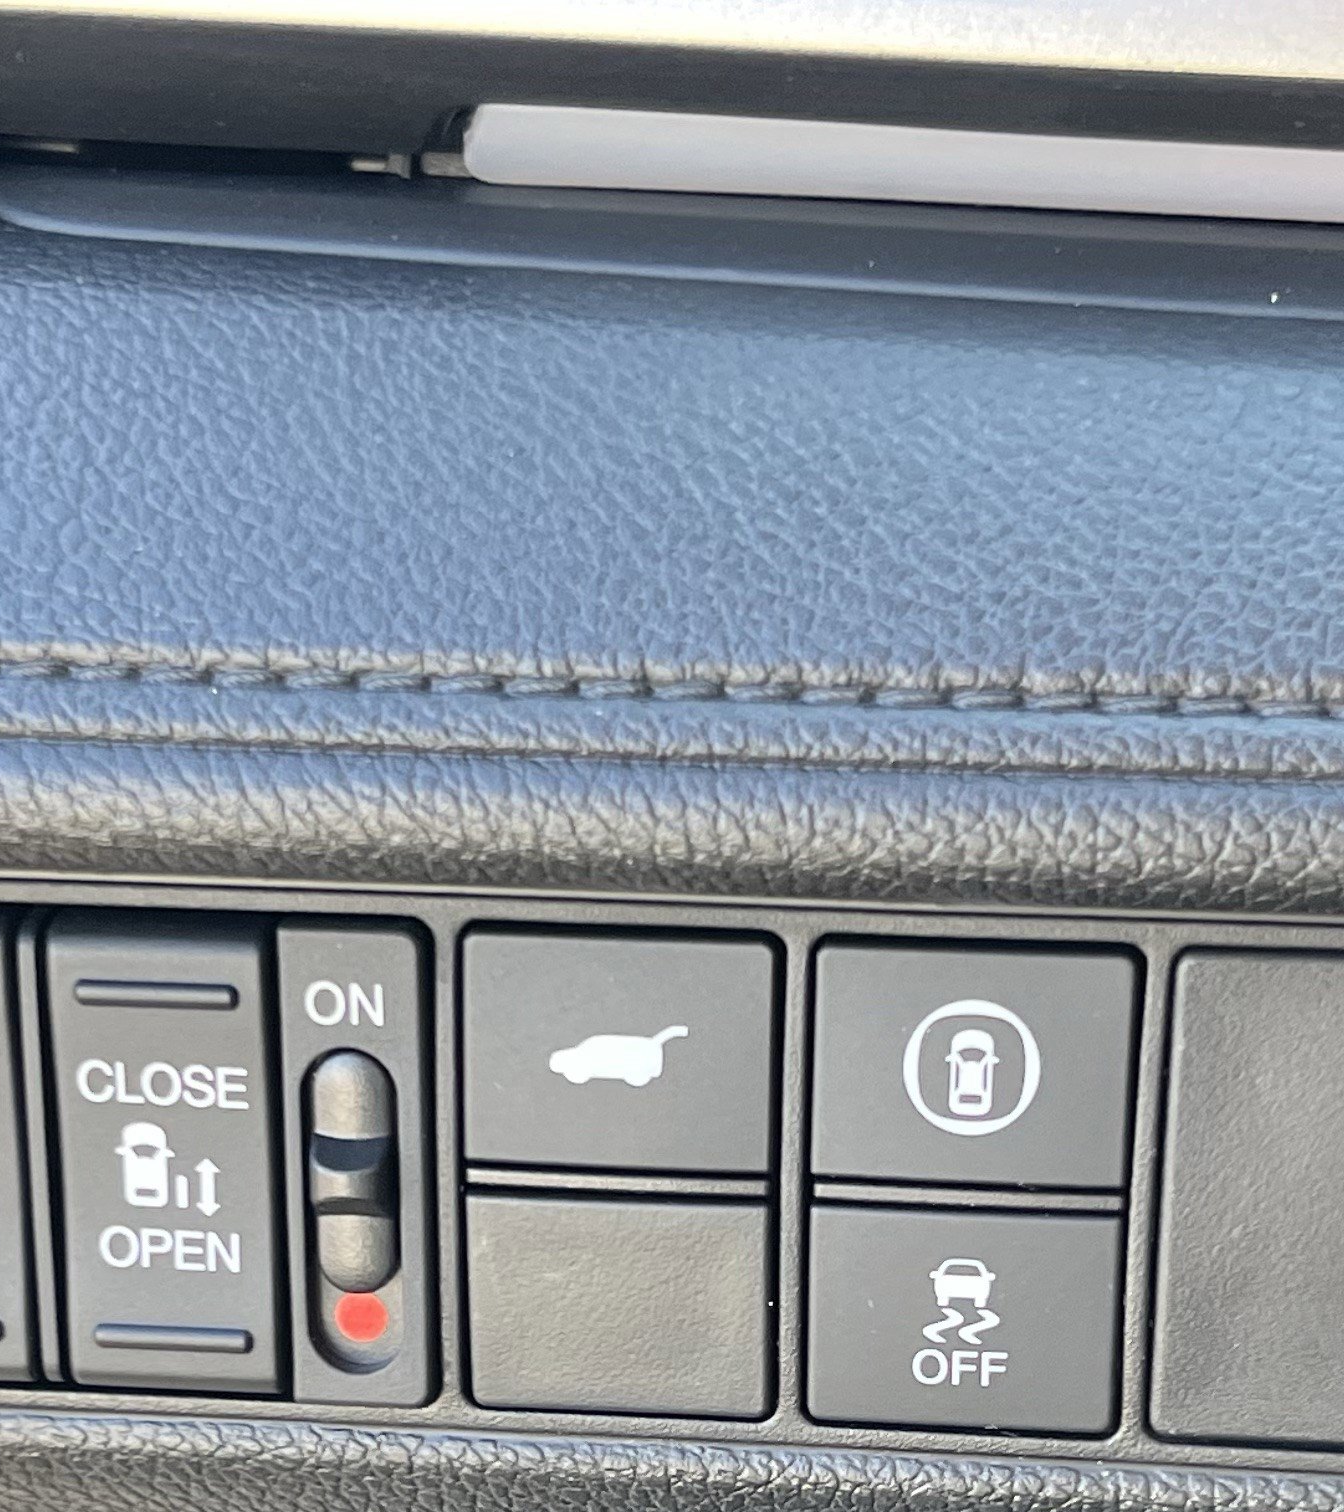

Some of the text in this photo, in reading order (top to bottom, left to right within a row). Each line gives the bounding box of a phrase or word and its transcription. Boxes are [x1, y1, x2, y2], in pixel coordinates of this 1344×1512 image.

[304, 980, 384, 1027] ON
[76, 1059, 250, 1110] CLOSE
[99, 1225, 242, 1274] OPEN
[912, 1348, 1009, 1387] OFF
